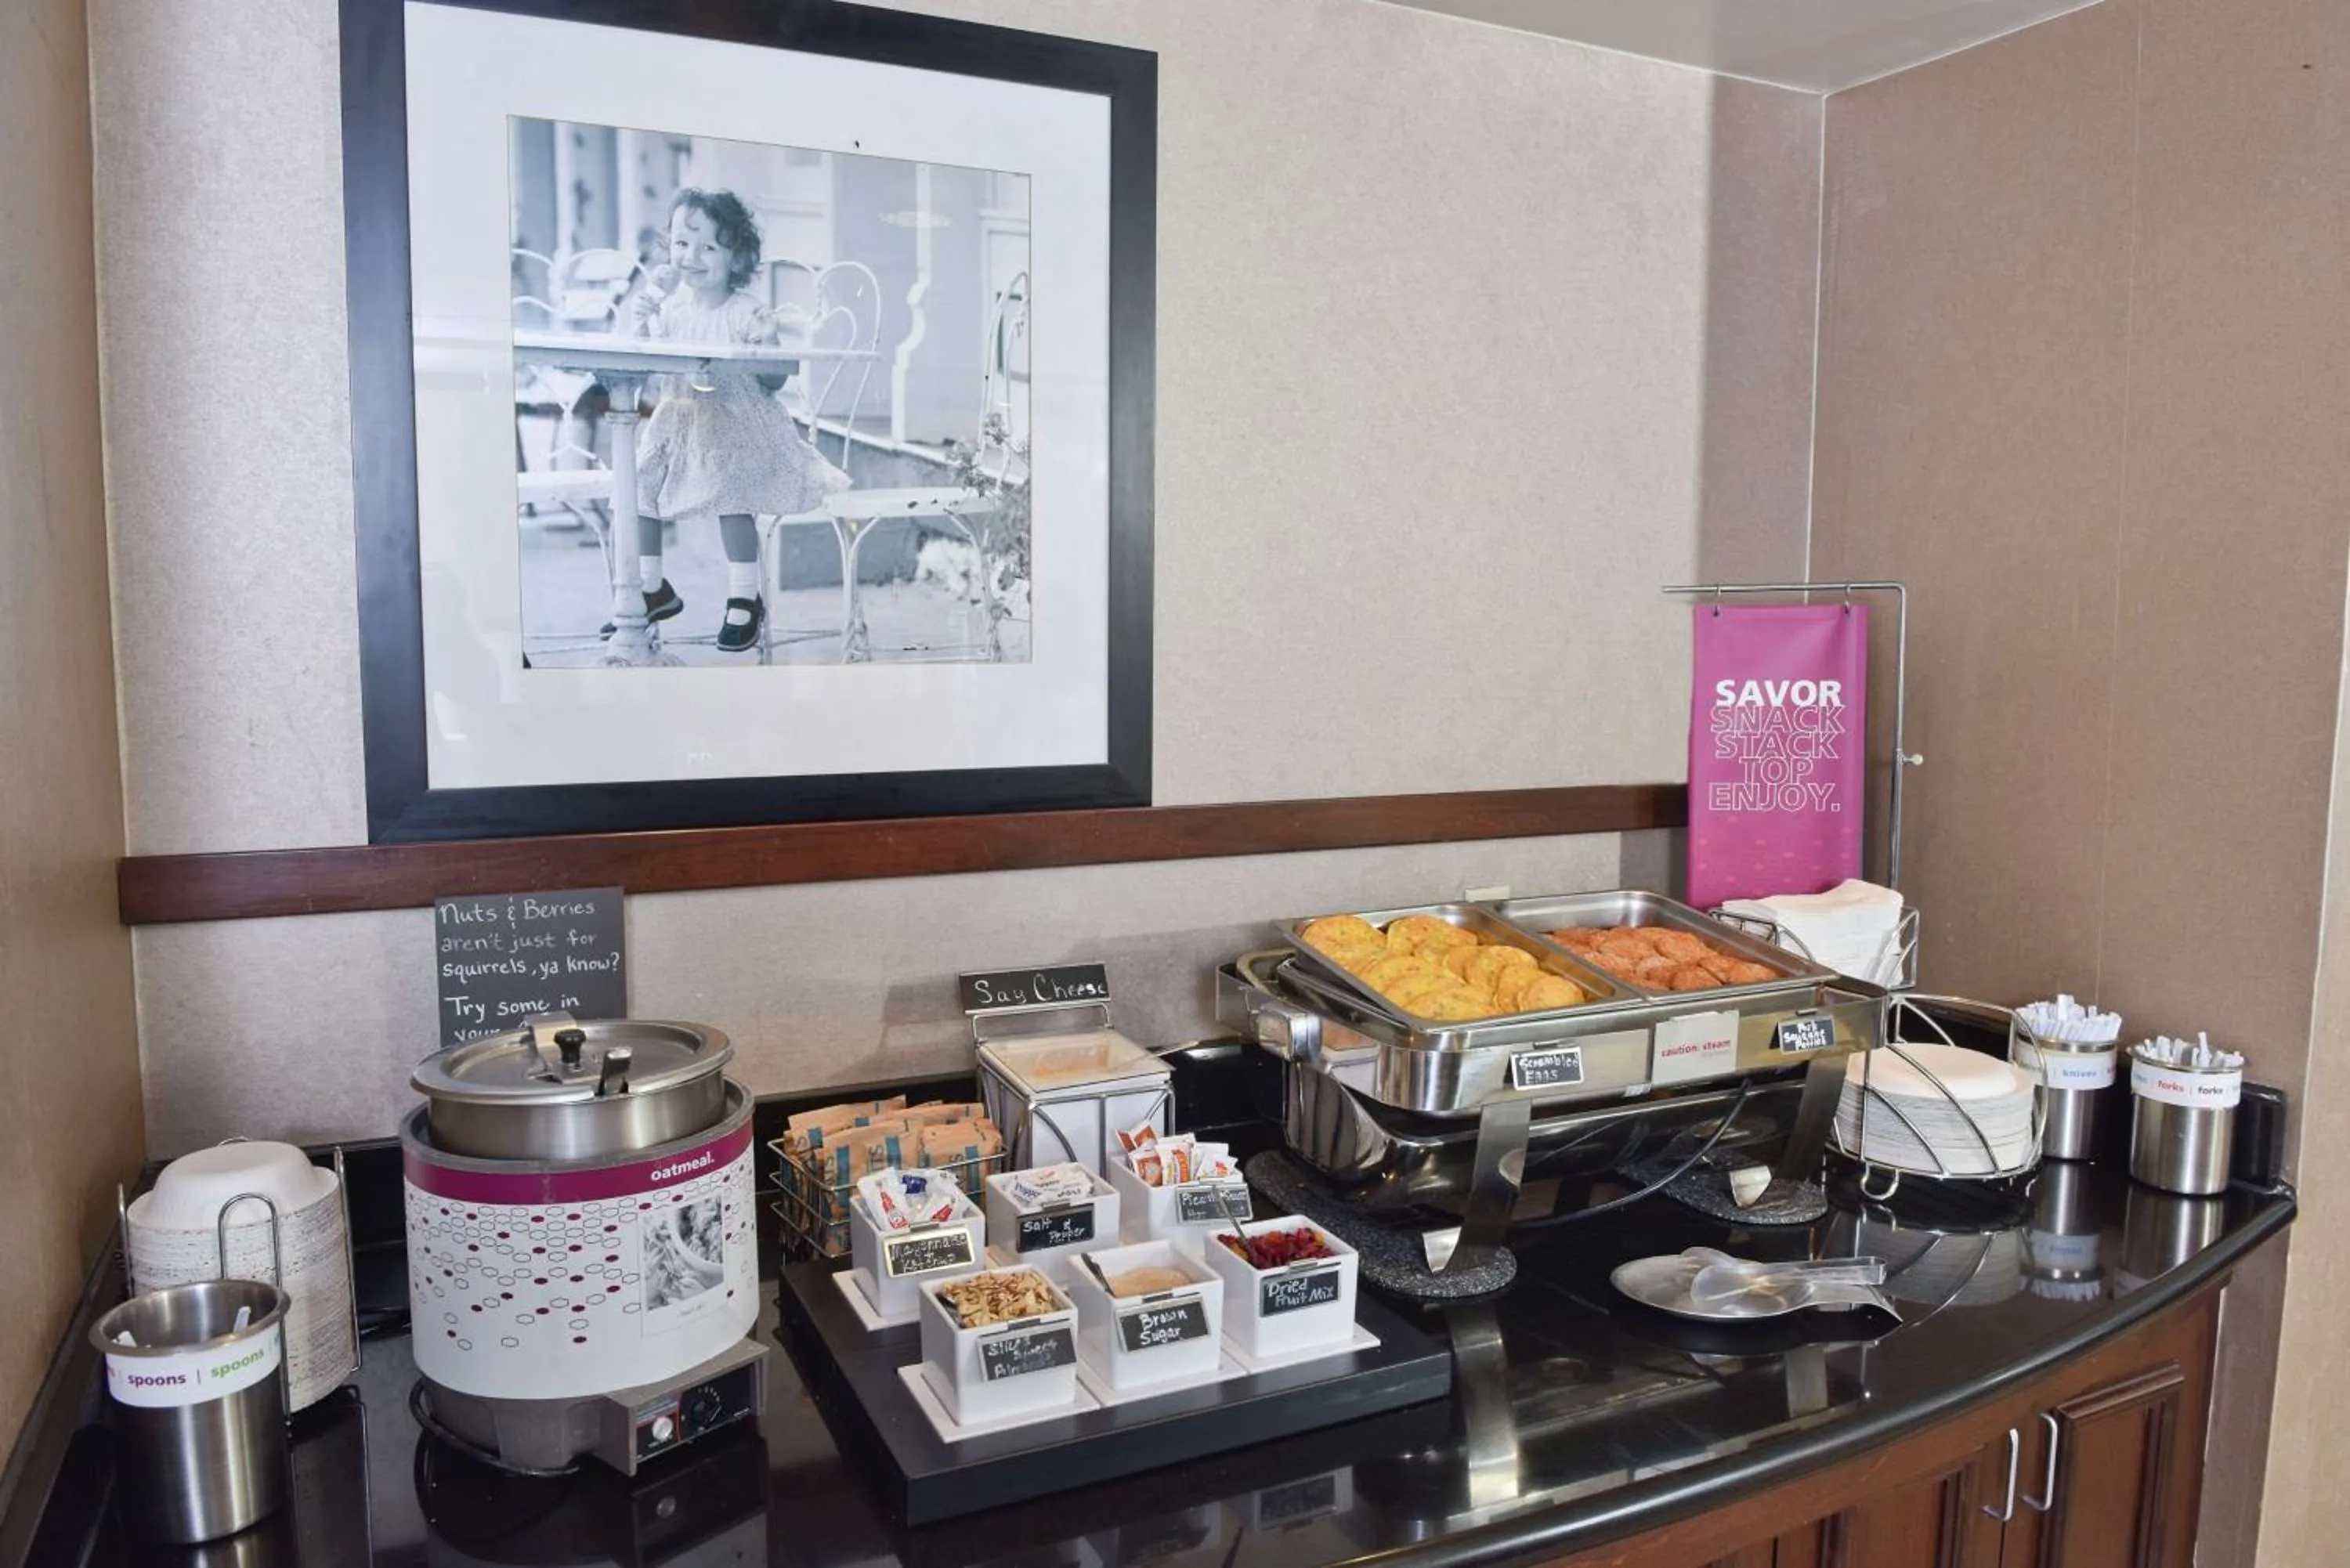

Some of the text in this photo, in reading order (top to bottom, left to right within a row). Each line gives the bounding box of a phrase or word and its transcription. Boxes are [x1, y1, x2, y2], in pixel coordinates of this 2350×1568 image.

[1716, 679, 1843, 706] SAVOR
[1711, 704, 1846, 733] SNACK
[1715, 731, 1838, 759] STACK
[1739, 756, 1813, 786] TOP
[1709, 782, 1840, 812] ENJOY.
[439, 903, 497, 924] Nuts
[522, 898, 595, 920] Berries
[441, 929, 598, 953] aren't just for
[539, 962, 559, 980] ya
[566, 952, 620, 972] know?
[974, 973, 1107, 1004] Say Cheese
[444, 993, 580, 1024] Try some in
[2157, 1079, 2186, 1093] forks
[650, 1151, 715, 1181] oatmeal.
[1267, 1277, 1307, 1297] Dried
[1274, 1292, 1307, 1307] Fruit
[1140, 1328, 1181, 1346] Sugar
[128, 1348, 265, 1389] spoons spoons
